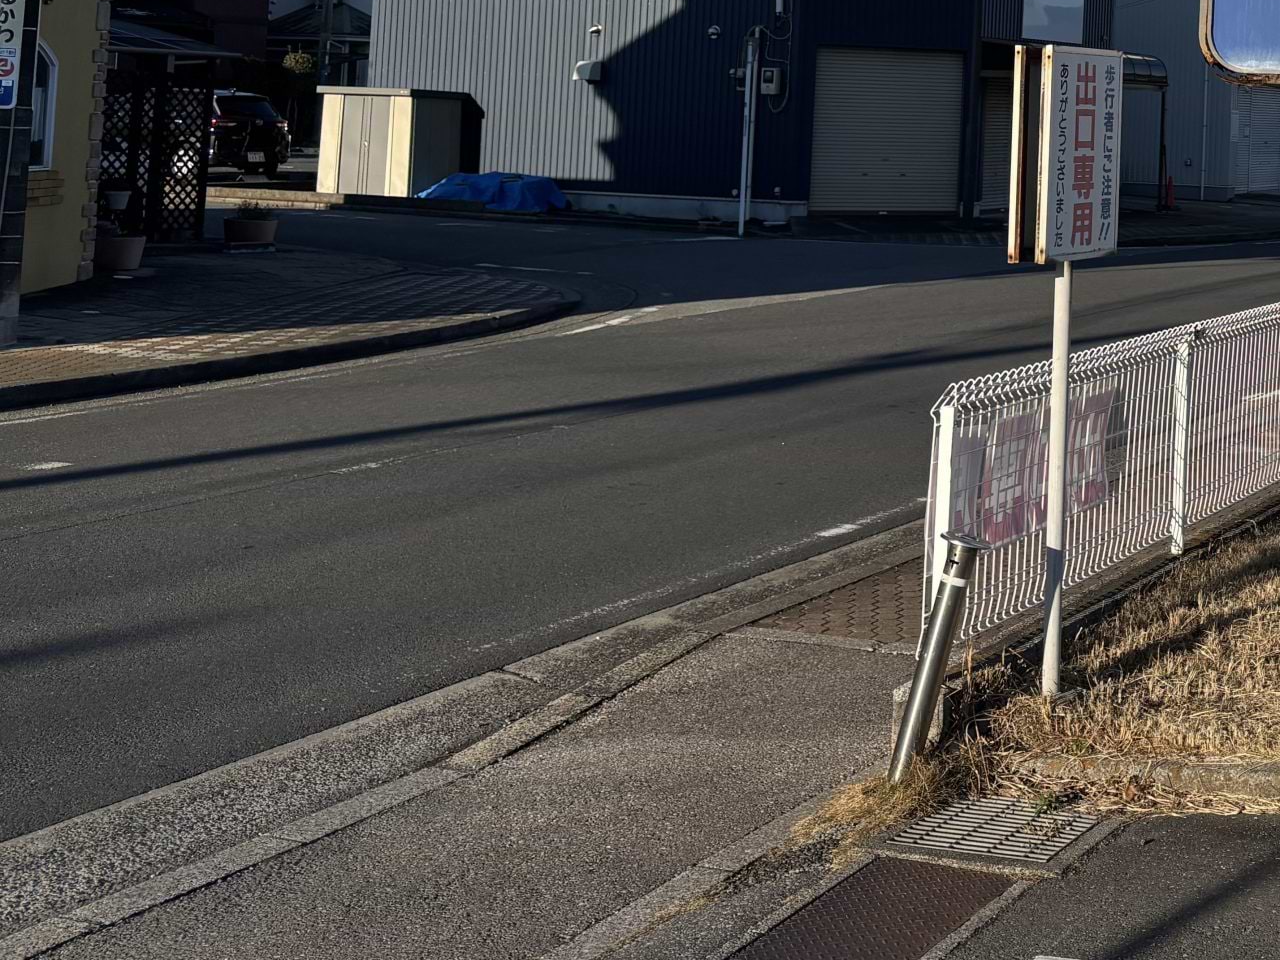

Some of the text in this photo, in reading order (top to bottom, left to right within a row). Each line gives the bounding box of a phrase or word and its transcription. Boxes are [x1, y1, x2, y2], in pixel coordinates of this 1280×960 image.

[1053, 64, 1069, 247] ありがとうございました
[1071, 61, 1097, 248] 出口専用
